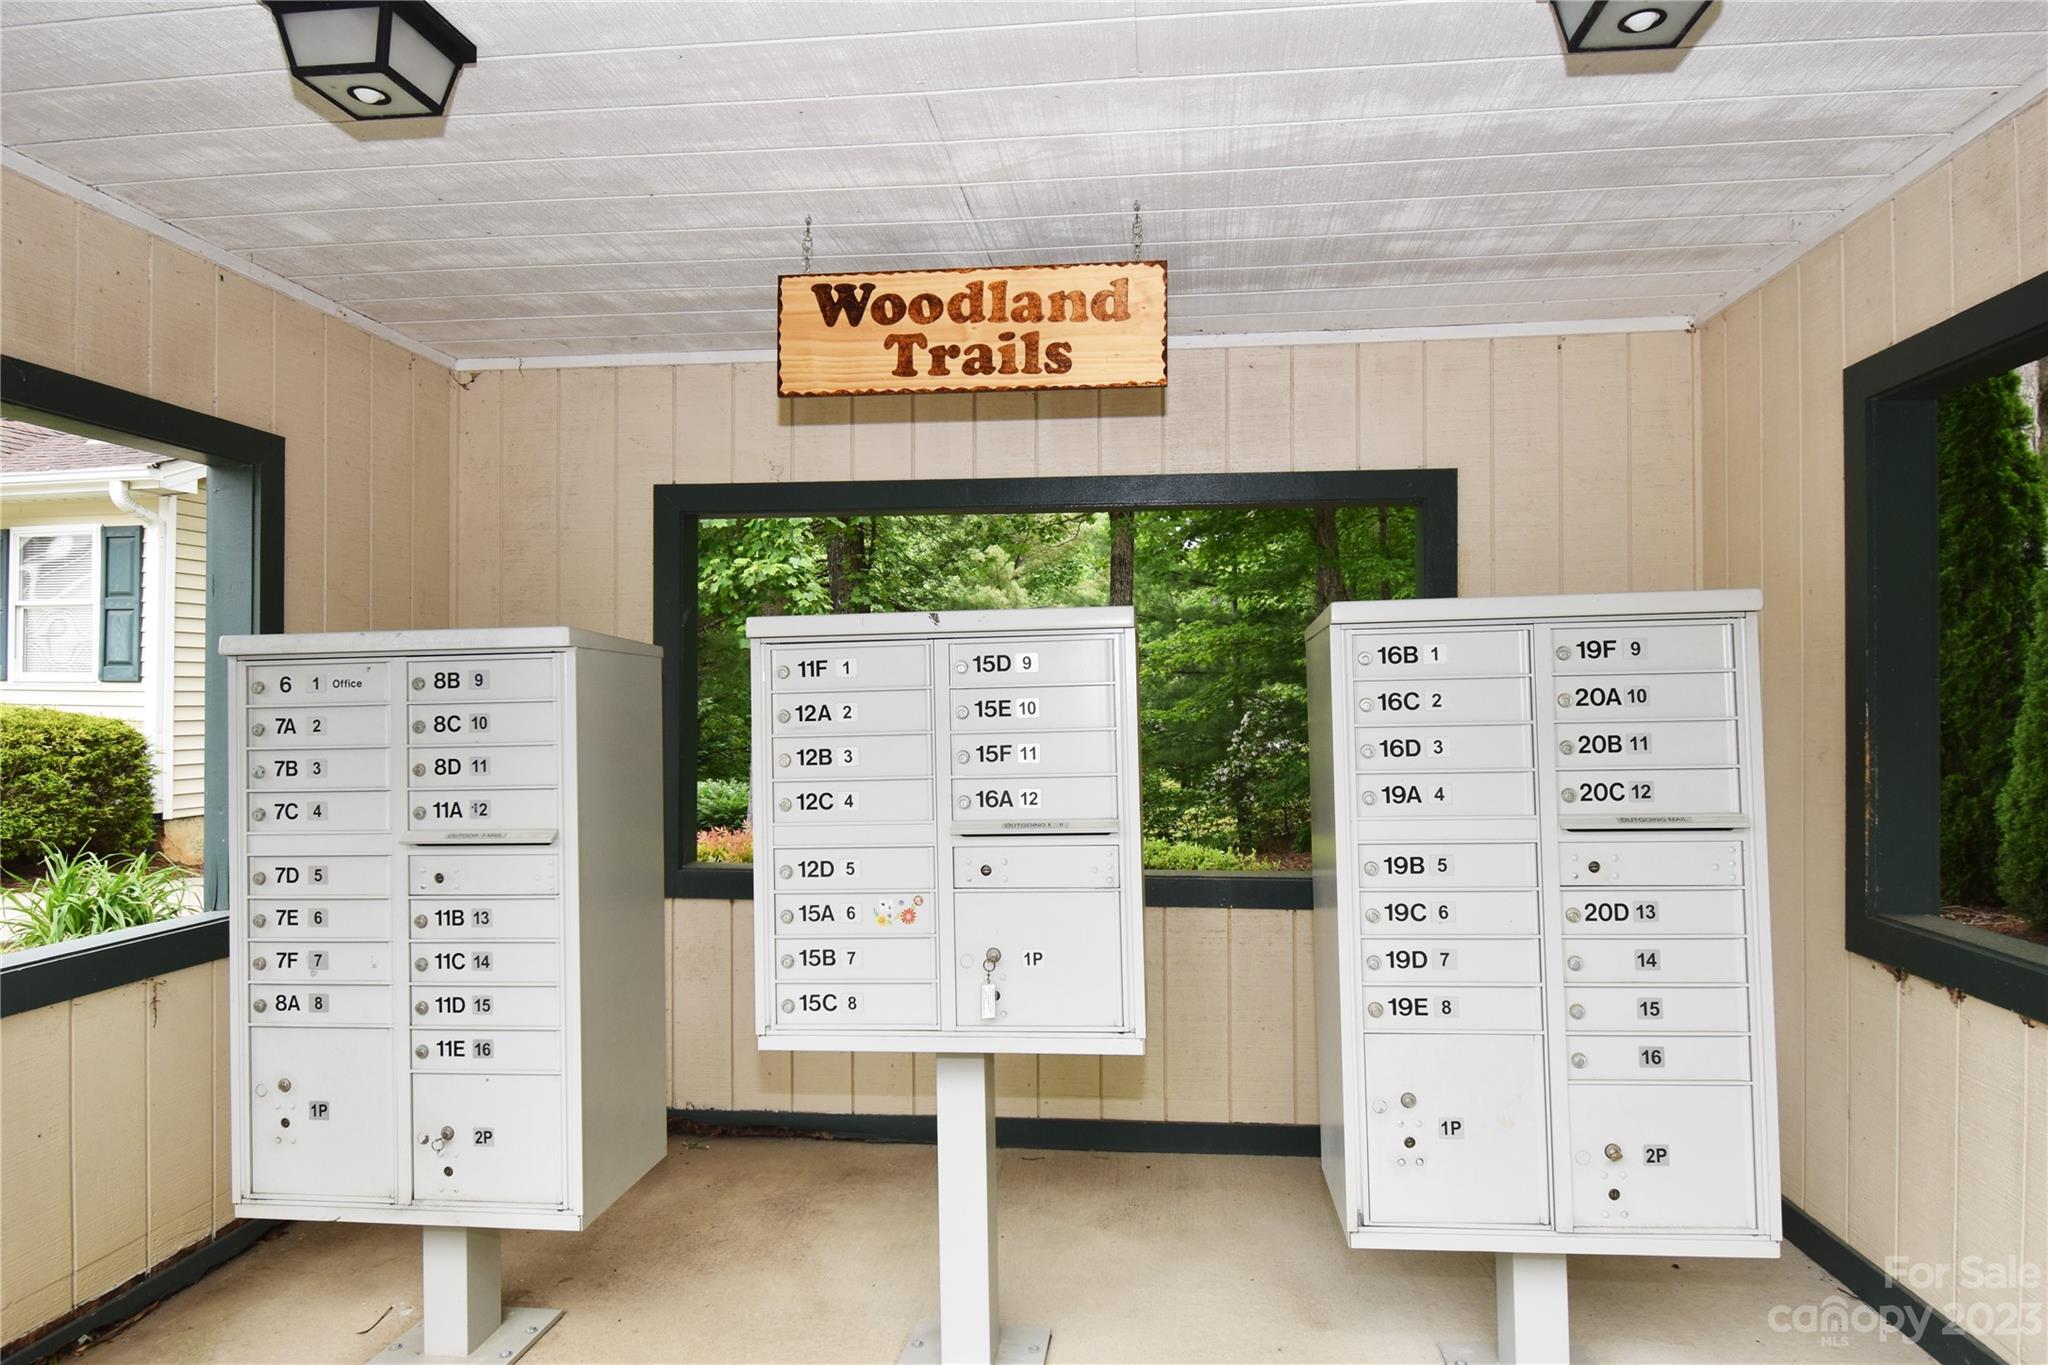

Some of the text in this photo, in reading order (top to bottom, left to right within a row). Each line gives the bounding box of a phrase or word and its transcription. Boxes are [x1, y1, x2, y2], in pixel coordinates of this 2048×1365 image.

[811, 277, 1131, 328] Woodland
[884, 331, 1073, 377] Trails
[1377, 645, 1439, 665] 16B 1
[1575, 639, 1641, 660] 19F 9
[797, 659, 850, 678] 11F 1
[972, 654, 1032, 673] 15D 9
[279, 675, 363, 694] 6 1 Office
[433, 671, 484, 690] 8B 9
[1377, 691, 1442, 711] 16C 2
[1575, 687, 1647, 707] 20A 10
[794, 704, 852, 722] 12A 2
[974, 699, 1037, 718] 15E 10
[275, 717, 321, 735] 7A 2
[433, 714, 488, 733] 8C 10
[975, 744, 1036, 763] 15F 11
[1379, 738, 1444, 758] 16D 3
[1578, 734, 1648, 754] 20B 11
[796, 748, 853, 766] 12B 3
[274, 760, 322, 777] 7B 3
[434, 758, 487, 776] 8D 11
[796, 792, 854, 811] 12C 4
[975, 789, 1038, 808] 16A 12
[1381, 785, 1445, 805] 19A 4
[1579, 782, 1652, 802] 20C 12
[274, 802, 322, 820] 7C 4
[432, 801, 488, 819] 11A 12
[274, 866, 323, 884] 7D 5
[797, 860, 855, 878] 12D 5
[1383, 856, 1448, 875] 19B 5
[275, 909, 323, 926] 7E 6
[434, 909, 490, 927] 11B 13
[798, 904, 856, 923] 15A 6
[1384, 902, 1449, 922] 19C 6
[1584, 902, 1656, 922] 20D 13
[276, 952, 323, 969] 7F 7
[434, 952, 491, 971] 11C 14
[798, 948, 856, 967] 15B 7
[1023, 951, 1043, 966] 1P
[1385, 950, 1450, 969] 19D 7
[1637, 952, 1658, 968] 14
[275, 994, 323, 1012] 8A 8
[435, 996, 491, 1014] 11D 15
[799, 993, 857, 1012] 15C 8
[1387, 997, 1452, 1017] 19E 8
[1639, 1001, 1660, 1017] 15
[436, 1040, 491, 1058] 11E 16
[1641, 1049, 1662, 1065] 16
[310, 1103, 328, 1118] 1P
[474, 1130, 493, 1145] 2P
[1441, 1120, 1462, 1136] 1P
[1646, 1147, 1667, 1164] 2P
